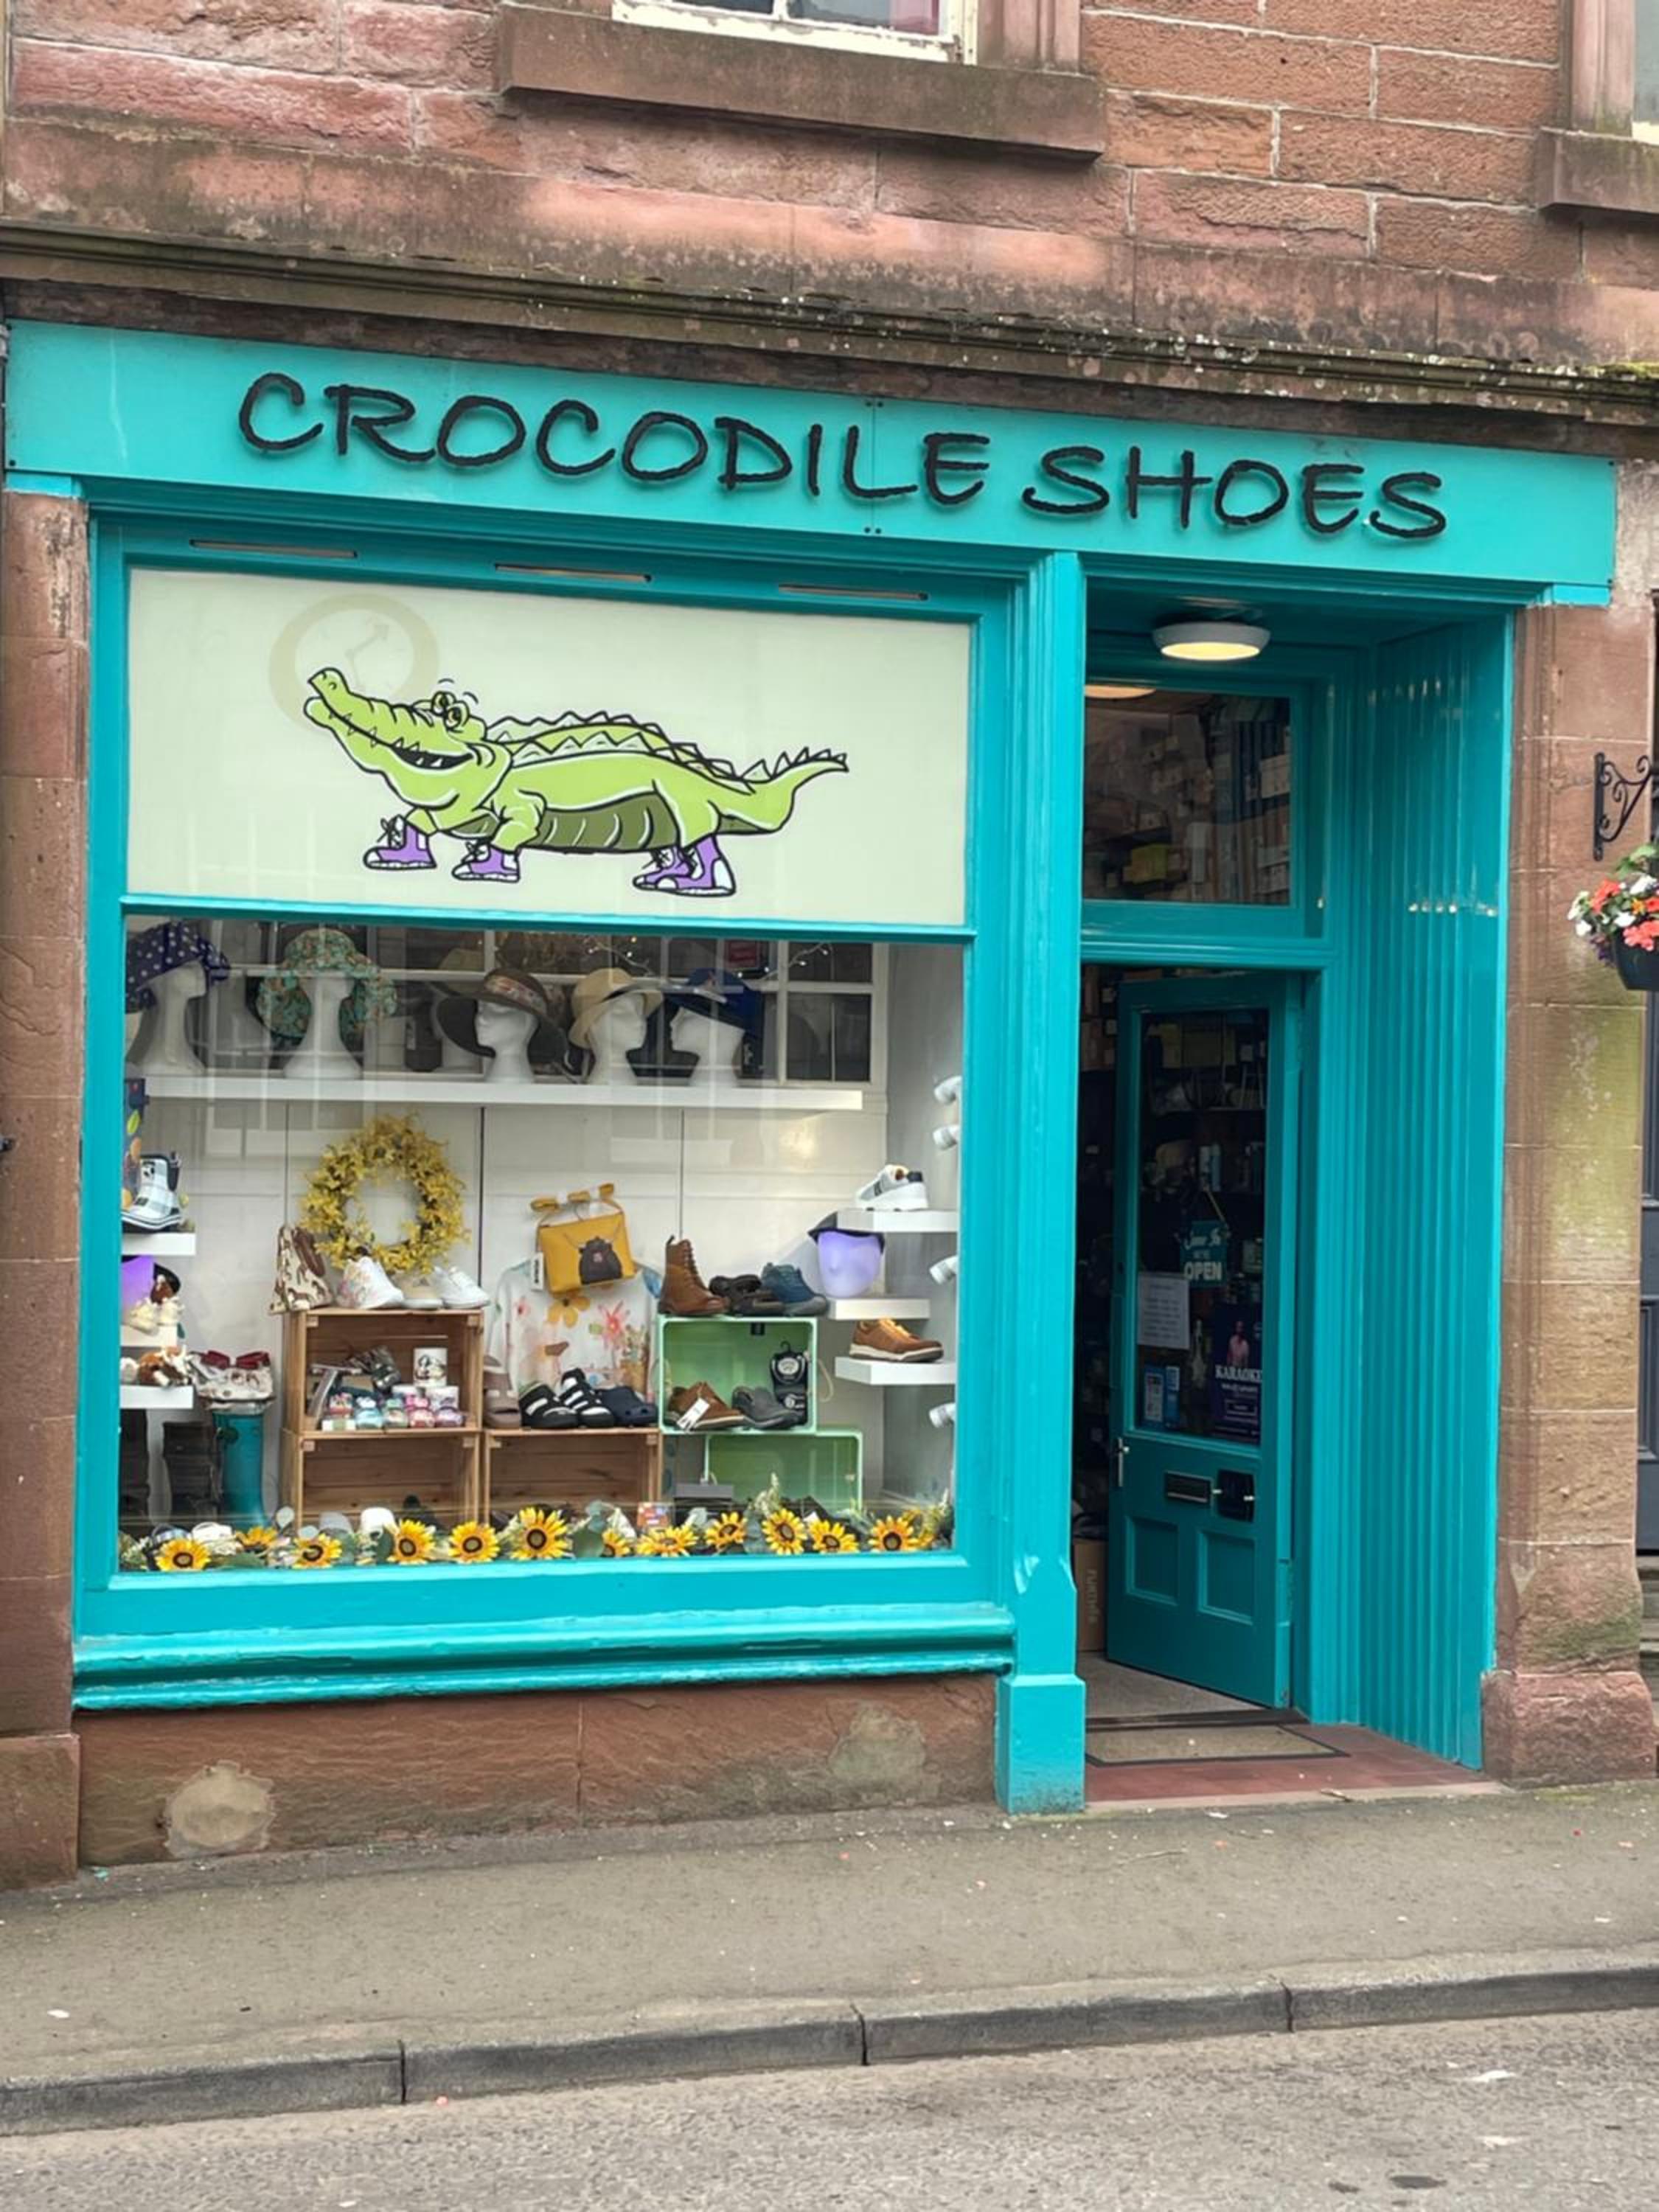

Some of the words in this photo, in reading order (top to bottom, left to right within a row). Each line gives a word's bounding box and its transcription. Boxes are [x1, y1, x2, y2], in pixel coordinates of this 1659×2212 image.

[238, 372, 990, 506] CROCODILE
[1022, 445, 1447, 540] SHOES
[1183, 1261, 1222, 1281] OPEN
